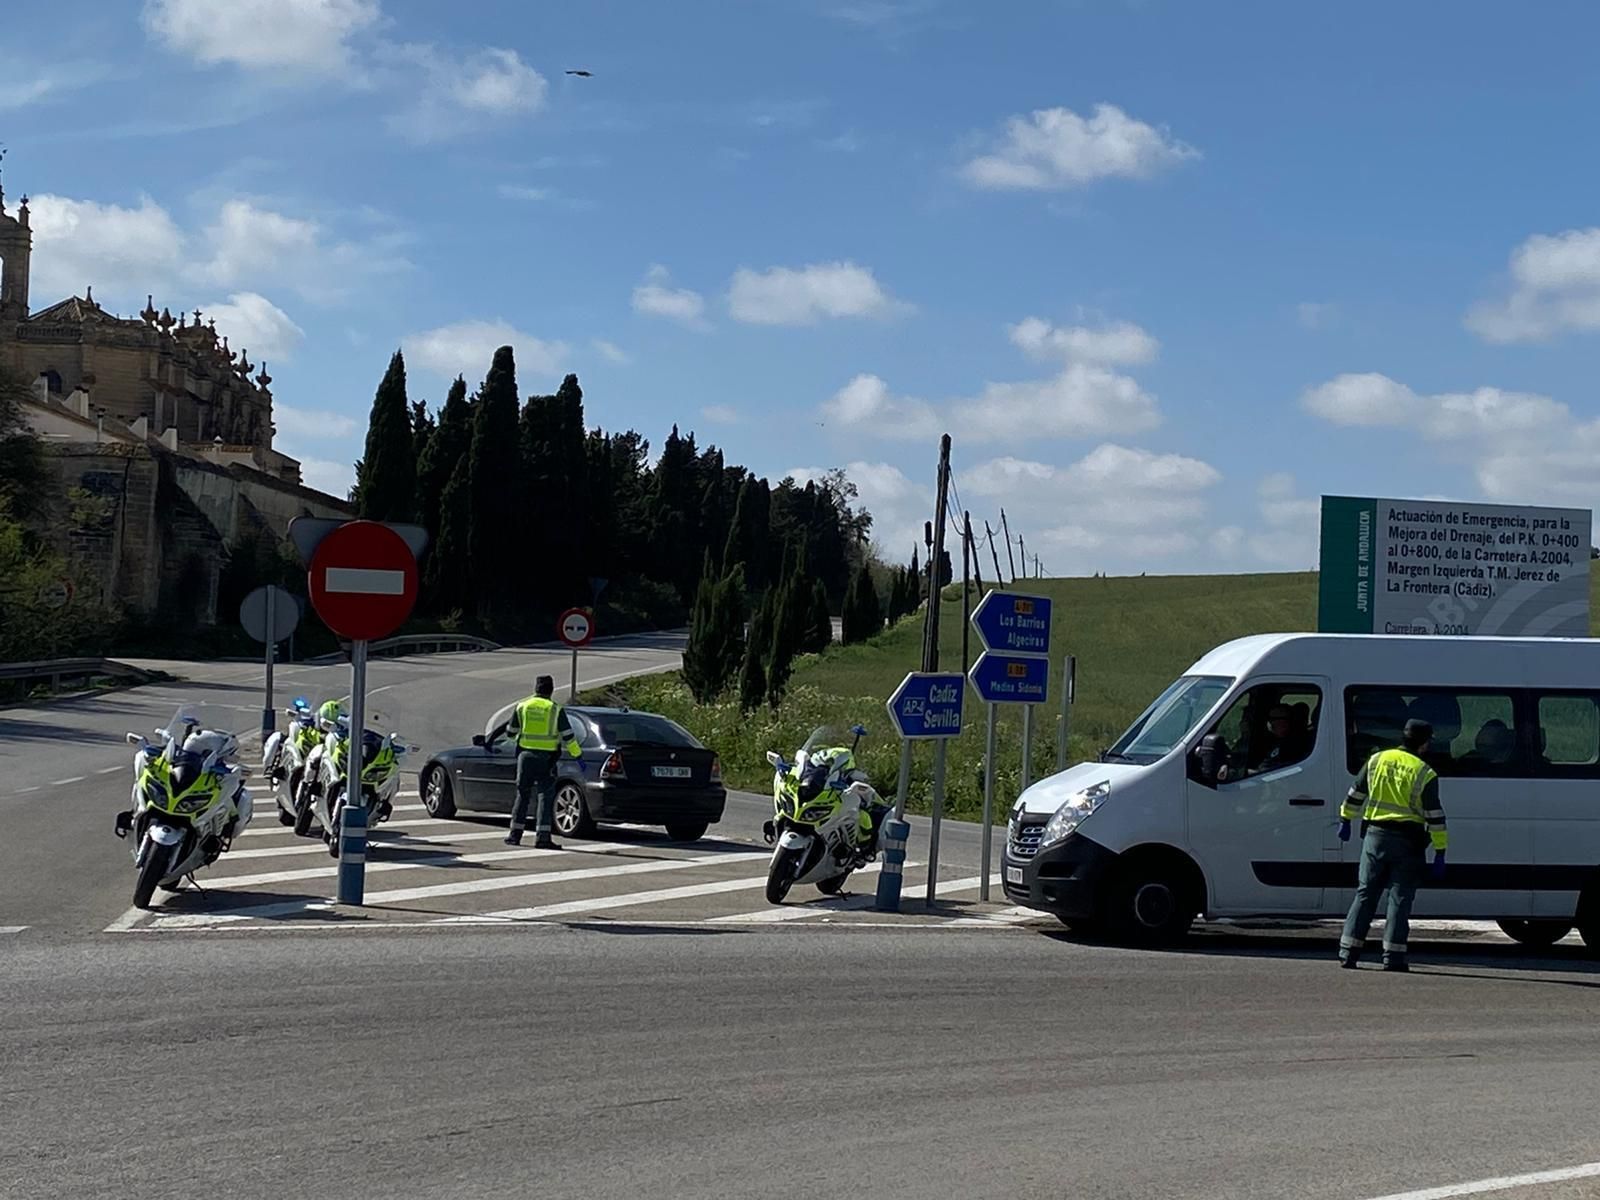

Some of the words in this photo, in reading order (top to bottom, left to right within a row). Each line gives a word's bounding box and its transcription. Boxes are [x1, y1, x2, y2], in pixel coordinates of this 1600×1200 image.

[1388, 508, 1442, 523] Actuación
[1446, 511, 1459, 524] de
[1462, 512, 1529, 530] Emergencia,
[1533, 518, 1557, 531] para
[1560, 517, 1570, 530] la
[1388, 526, 1427, 542] Mejora
[1430, 528, 1447, 542] del
[1450, 529, 1496, 546] Drenaje,
[1498, 532, 1515, 545] del
[1518, 532, 1539, 546] P.K.
[1542, 533, 1580, 548] 0+400
[1387, 543, 1398, 557] al
[1401, 544, 1442, 560] 0+800,
[1445, 547, 1458, 560] de
[1461, 547, 1471, 560] la
[1474, 548, 1527, 563] Carretera
[1530, 550, 1574, 568] A-2004,
[1358, 564, 1369, 577] DE
[1387, 561, 1430, 578] Margen
[1433, 563, 1484, 580] Izquierda
[1487, 565, 1511, 580] T.M.
[1514, 567, 1545, 581] Jerez
[1546, 569, 1560, 582] de
[1387, 579, 1400, 592] La
[1403, 580, 1450, 594] Frontera
[1357, 581, 1369, 613] JUNTA
[1000, 613, 1014, 627] Los
[1017, 615, 1045, 630] Barrios
[1007, 631, 1044, 648] Algeciras
[923, 708, 960, 728] Sevilla
